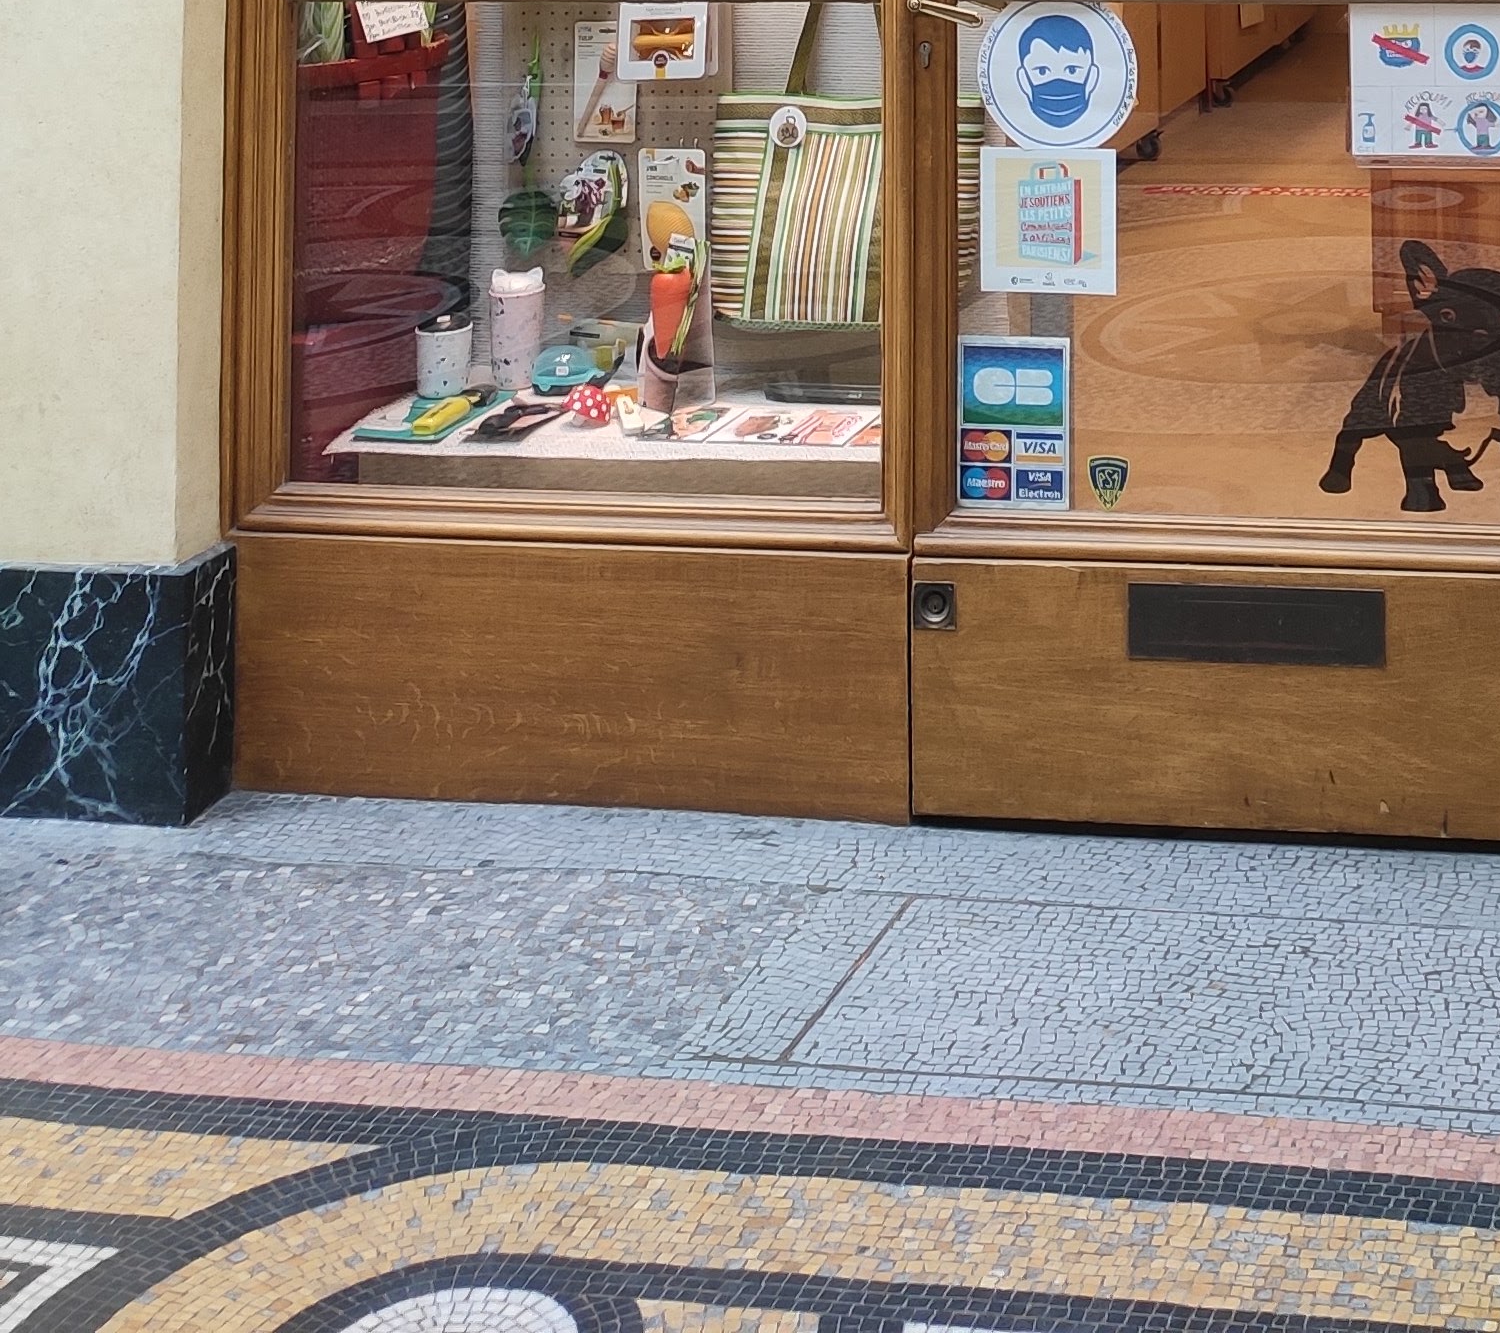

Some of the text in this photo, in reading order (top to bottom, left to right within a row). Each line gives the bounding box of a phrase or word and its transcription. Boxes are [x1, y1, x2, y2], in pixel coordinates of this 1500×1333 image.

[1029, 193, 1071, 208] SOUTIENS
[1037, 206, 1072, 221] PETITS
[1023, 442, 1057, 455] VISA
[1028, 471, 1052, 482] VISA
[1018, 487, 1061, 500] Electron
